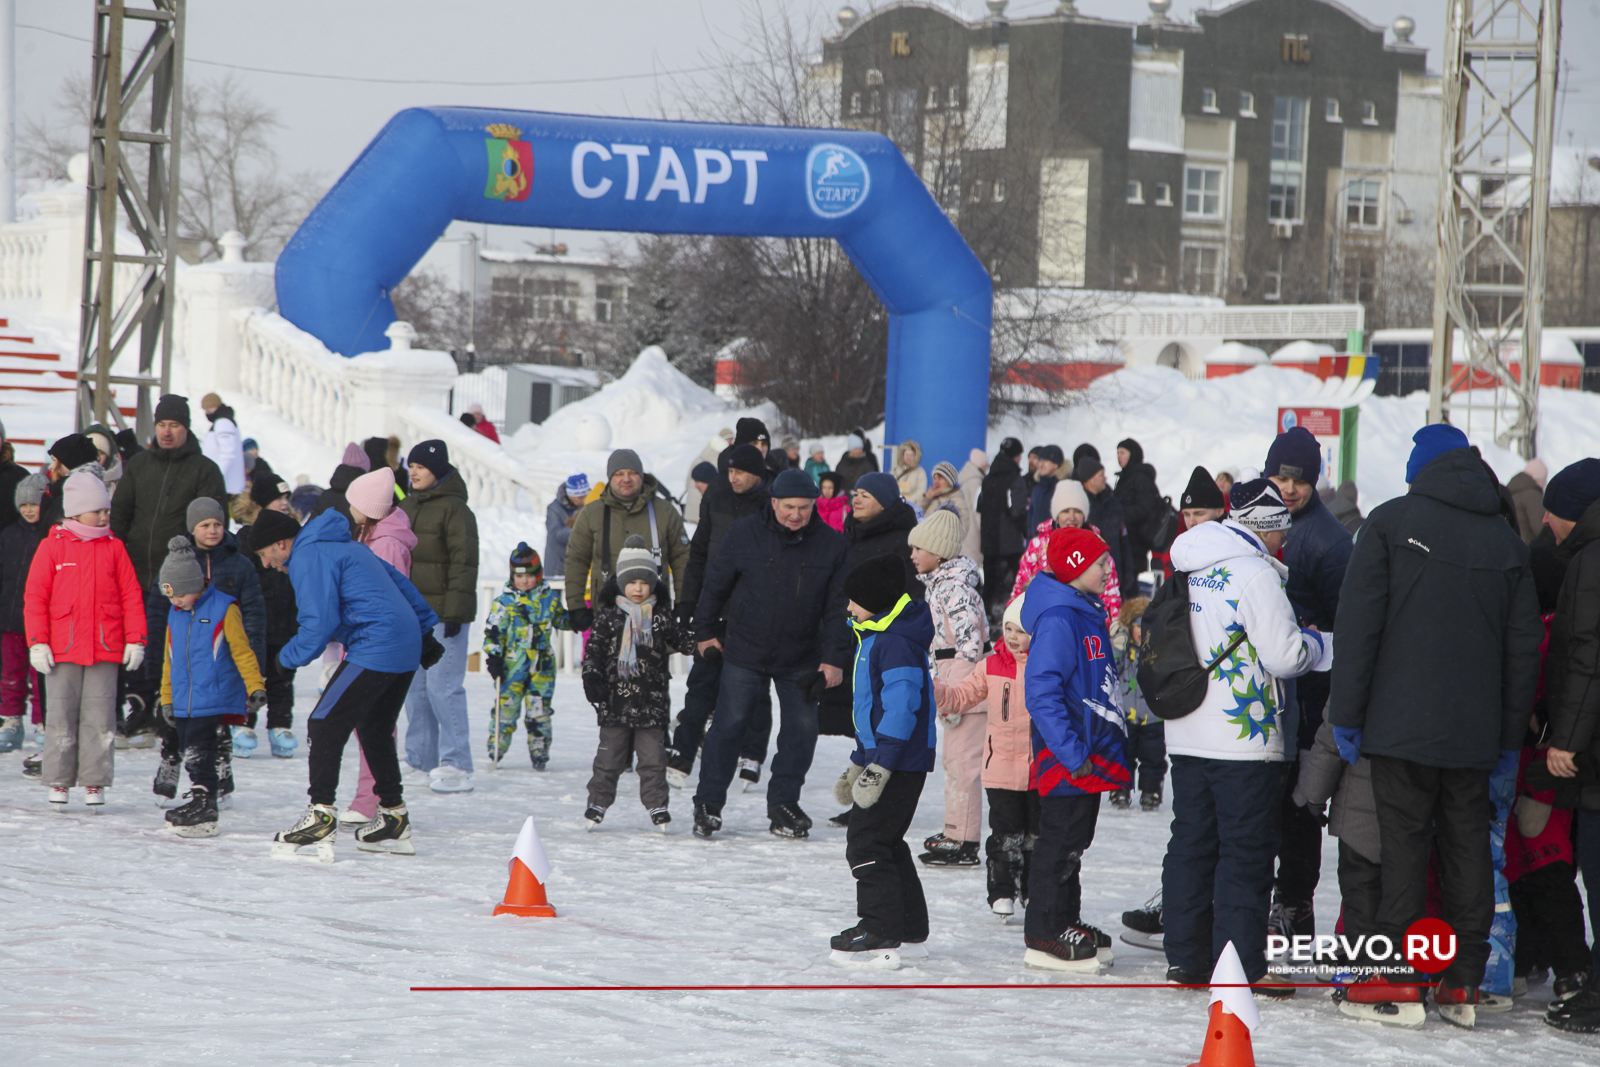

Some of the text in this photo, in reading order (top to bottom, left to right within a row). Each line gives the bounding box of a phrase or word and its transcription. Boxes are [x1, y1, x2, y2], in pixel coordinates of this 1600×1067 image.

[571, 141, 768, 206] СТАРТ
[816, 187, 860, 202] СТАРТ
[1413, 540, 1430, 553] Columbia
[1066, 550, 1085, 568] 12
[1187, 576, 1225, 591] овская
[1083, 635, 1106, 661] 12
